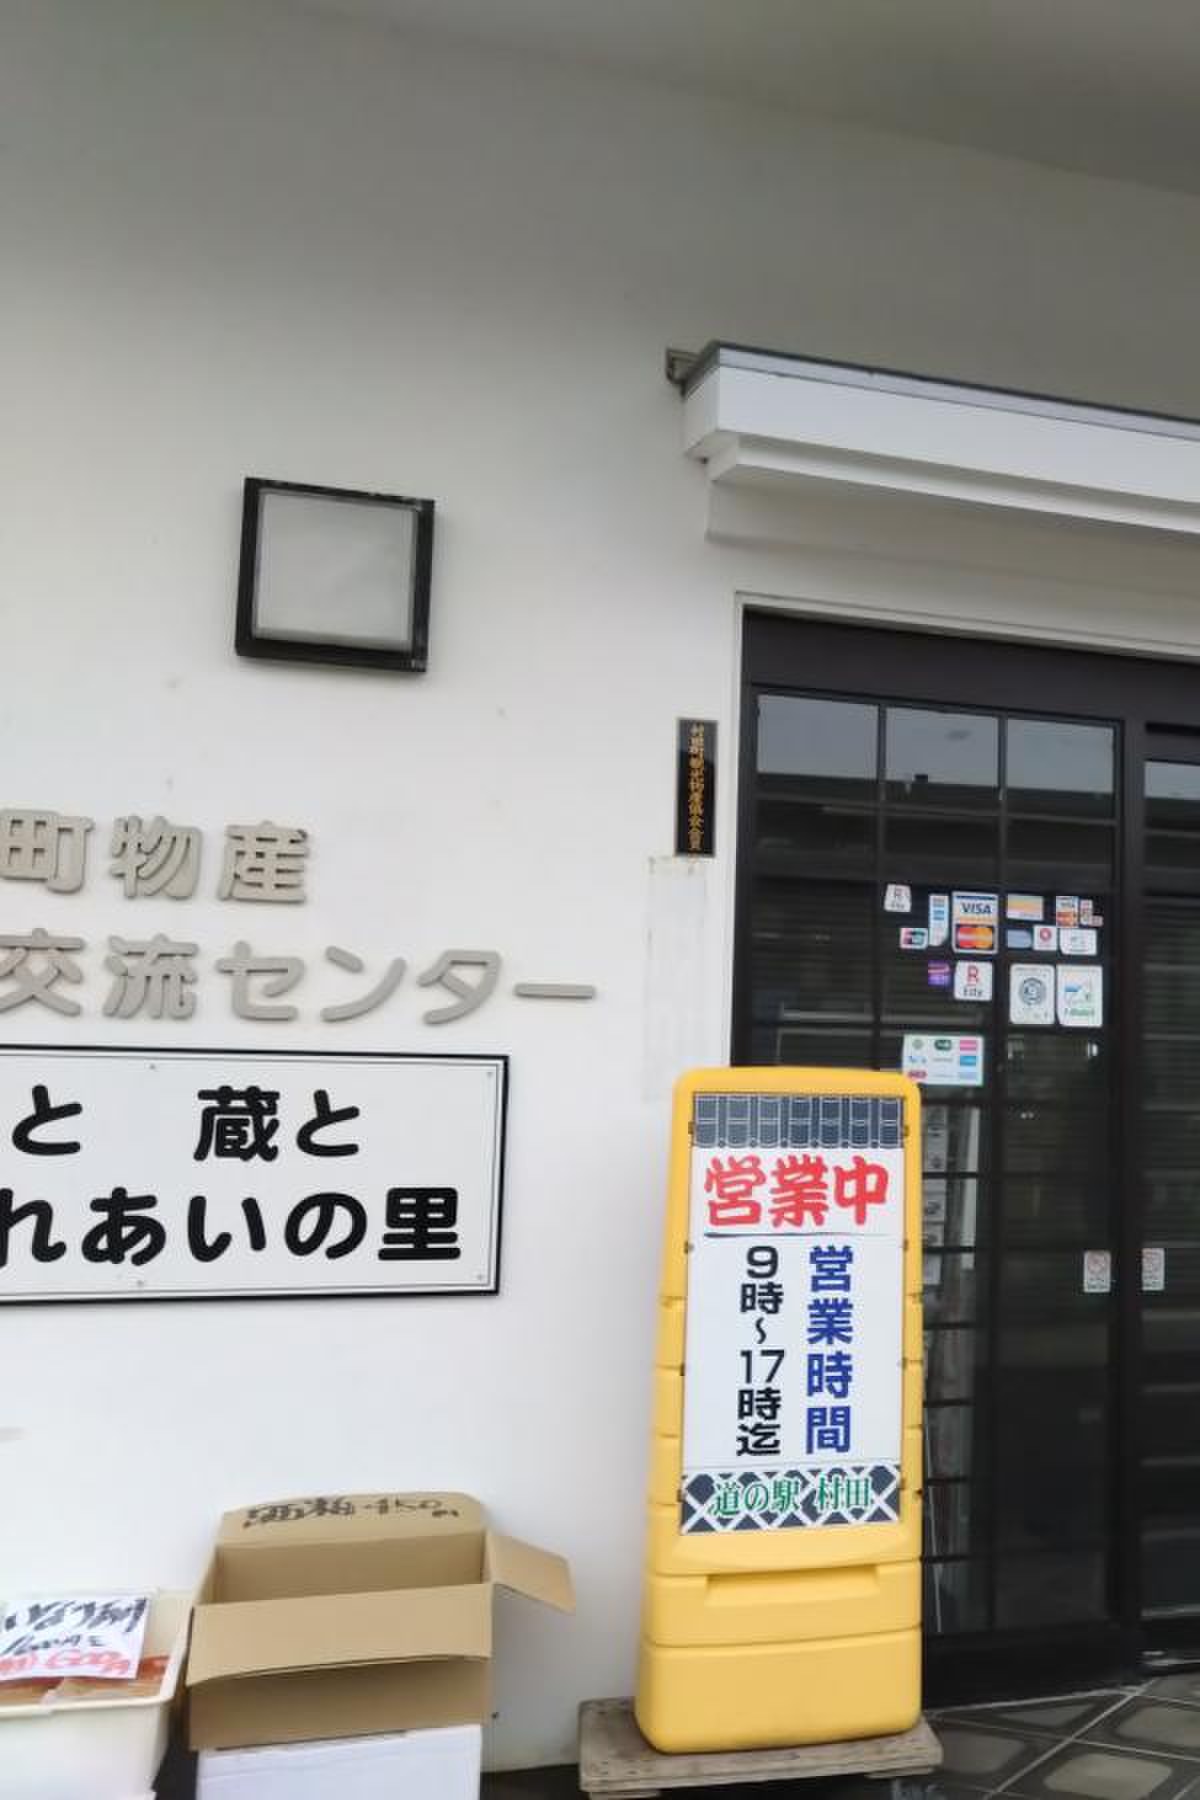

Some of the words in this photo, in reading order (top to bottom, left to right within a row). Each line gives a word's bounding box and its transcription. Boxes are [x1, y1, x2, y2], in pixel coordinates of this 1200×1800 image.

[0, 808, 310, 904] 町物産
[962, 903, 992, 915] VISA
[0, 928, 597, 1026] 交流センター
[12, 1084, 83, 1156] と
[194, 1086, 360, 1161] 蔵と
[0, 1187, 461, 1267] れあいの里
[704, 1154, 889, 1227] 営業中
[806, 1245, 854, 1454] 営業時間
[708, 1477, 801, 1517] 道の駅
[814, 1473, 874, 1511] 村田
